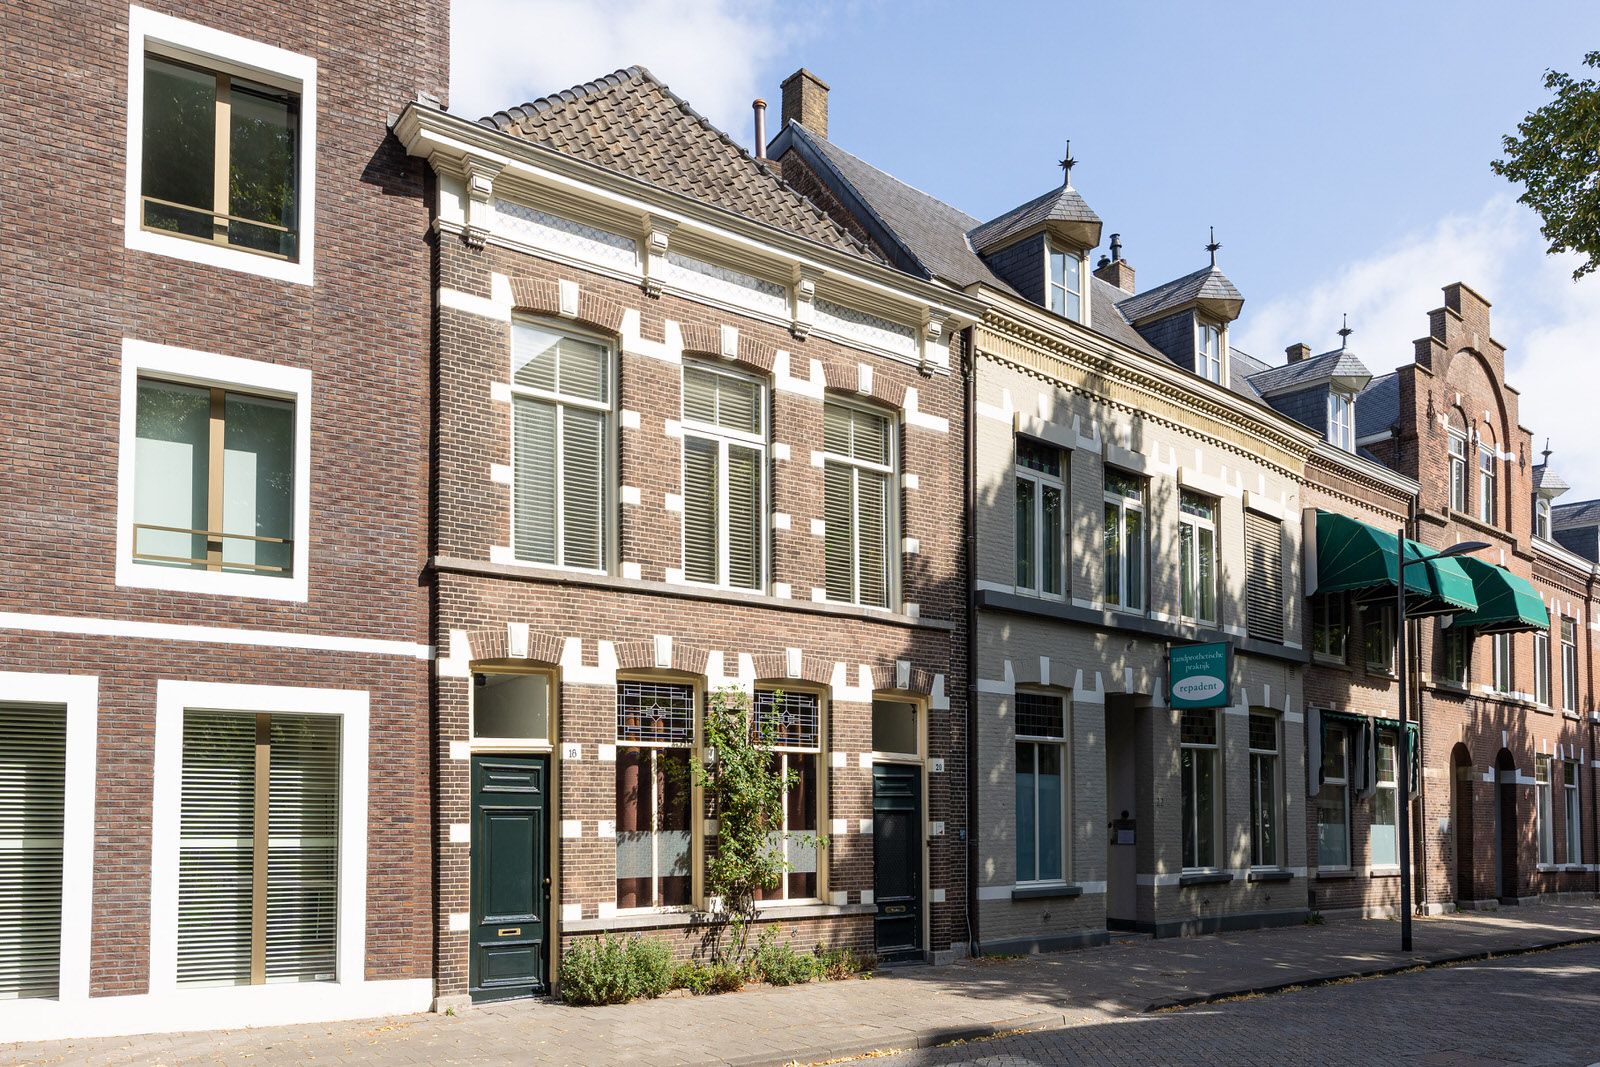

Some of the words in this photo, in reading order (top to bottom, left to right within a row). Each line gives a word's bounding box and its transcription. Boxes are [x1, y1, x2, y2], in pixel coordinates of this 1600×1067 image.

[1185, 661, 1210, 673] praktijk
[1179, 682, 1218, 694] repadent
[935, 763, 943, 771] 20
